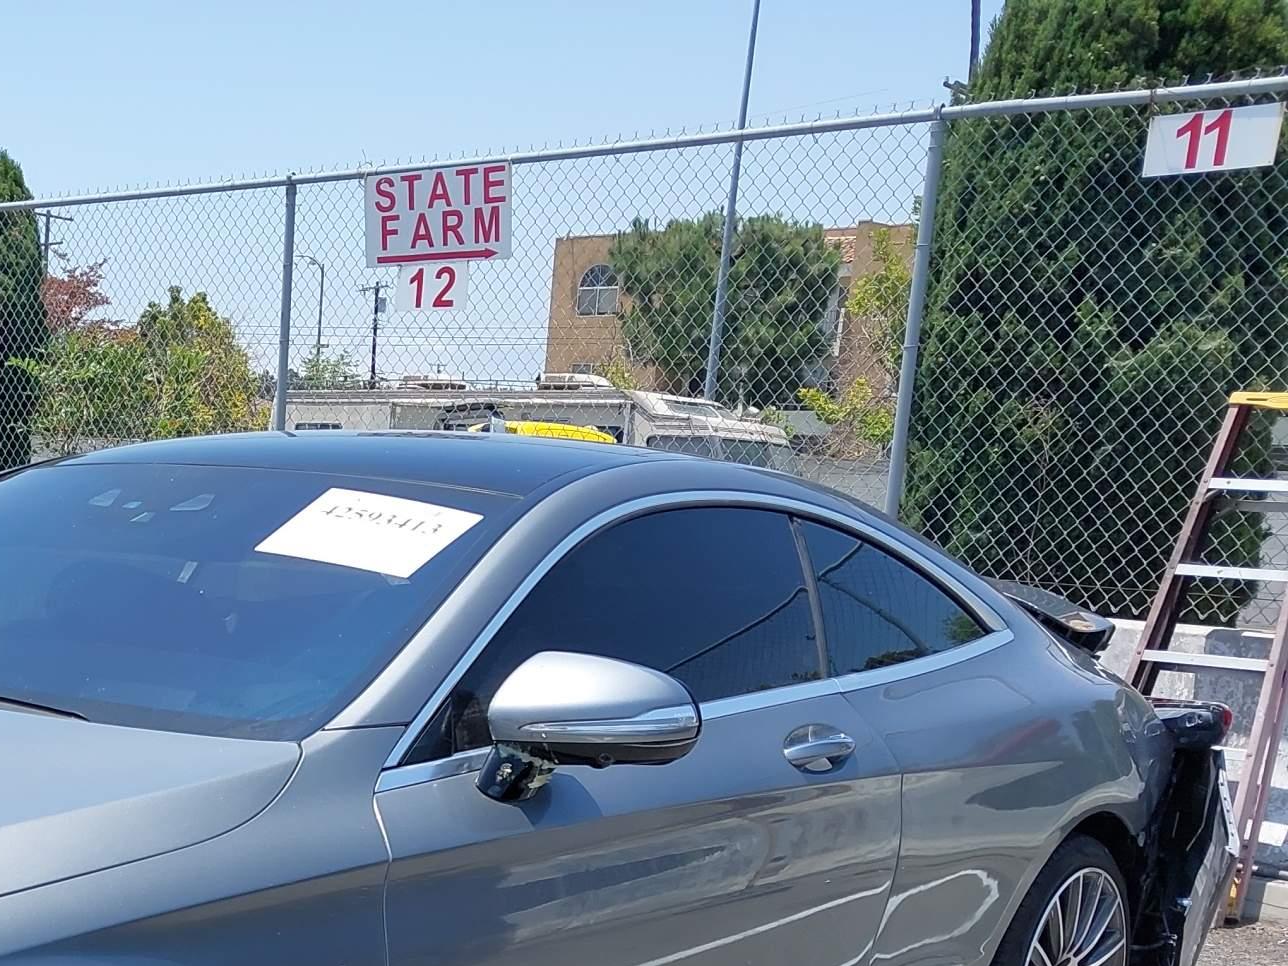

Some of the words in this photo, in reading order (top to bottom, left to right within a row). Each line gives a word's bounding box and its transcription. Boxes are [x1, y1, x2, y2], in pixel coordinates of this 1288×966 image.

[1176, 109, 1233, 169] 11
[374, 164, 506, 214] STATE
[381, 205, 500, 251] FARM
[409, 266, 457, 309] 12
[320, 503, 443, 535] 42593413
